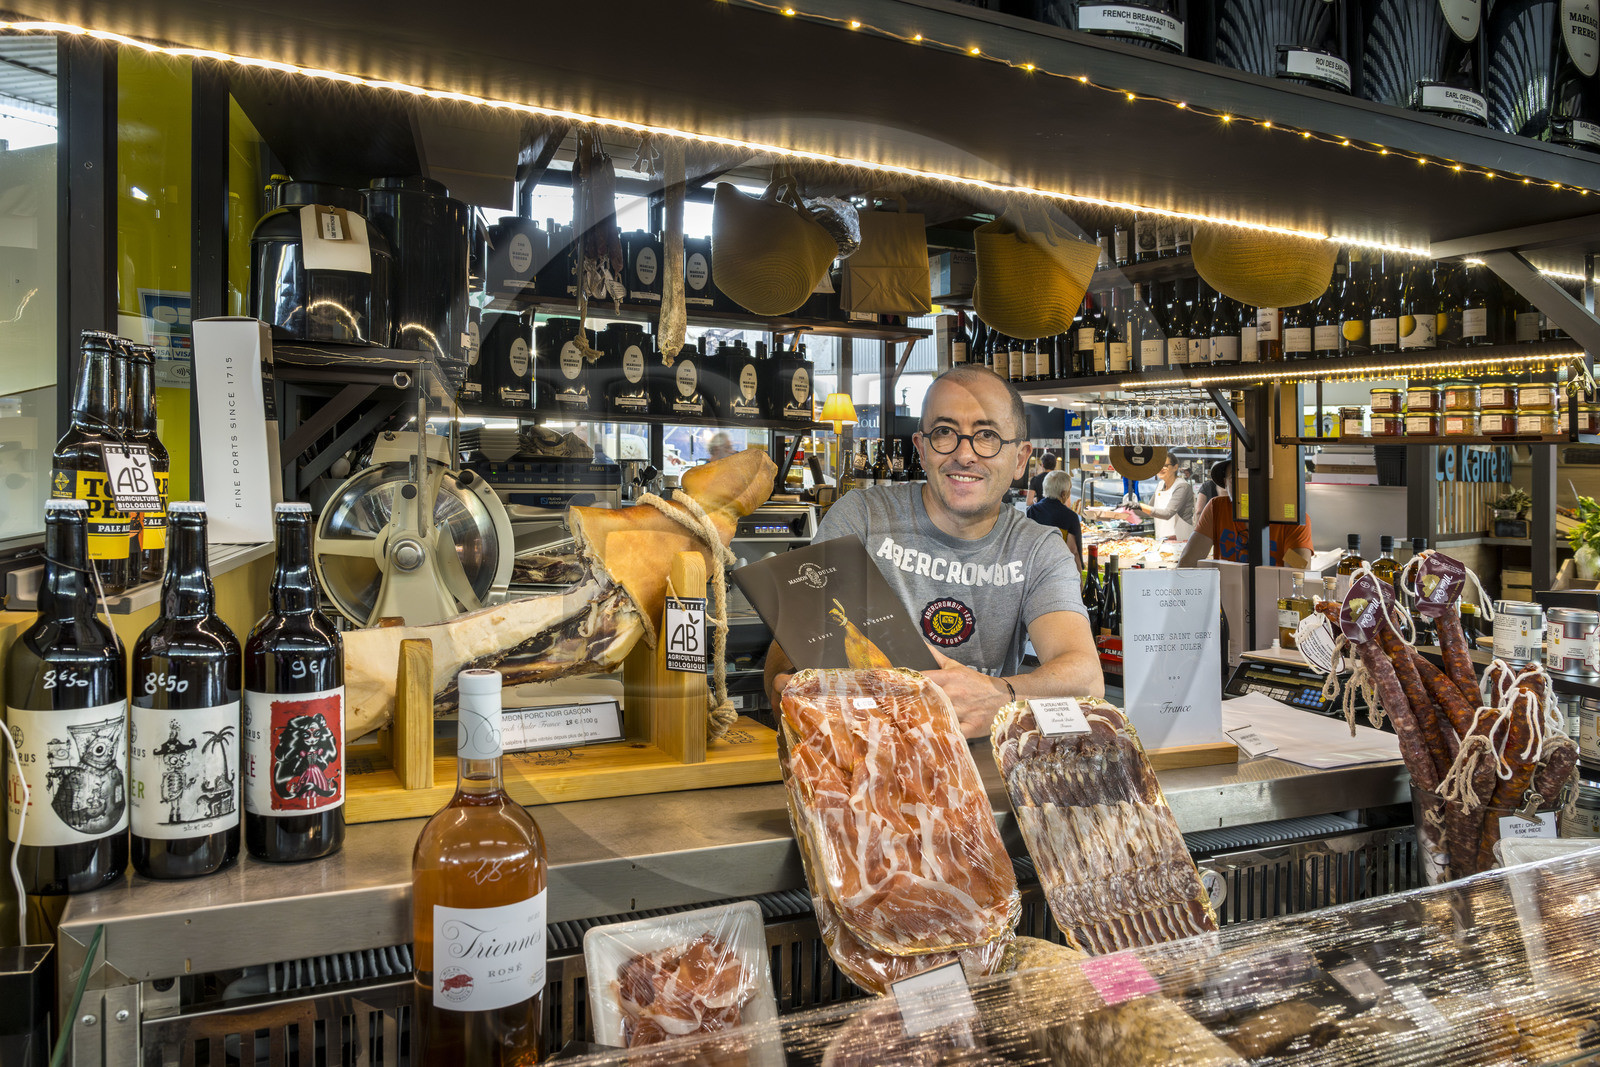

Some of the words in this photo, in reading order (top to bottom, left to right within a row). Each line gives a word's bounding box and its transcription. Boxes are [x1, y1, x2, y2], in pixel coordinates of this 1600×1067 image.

[1102, 10, 1131, 19] FRENCH
[1132, 12, 1166, 26] BREAKFAST
[1167, 20, 1176, 30] TEA
[1325, 60, 1334, 68] DES
[1445, 91, 1459, 99] EARL
[1460, 94, 1472, 102] GREY
[225, 357, 234, 384] 1715
[228, 392, 237, 428] SINCE
[231, 435, 240, 474] PORTS
[1435, 445, 1454, 481] Le
[117, 467, 149, 492] AB
[233, 480, 242, 508] FINE
[876, 537, 1025, 586] ABERCROMBIE
[788, 575, 808, 585] MAISON
[818, 567, 837, 576] DULER
[872, 614, 894, 624] COCHON
[924, 601, 962, 620] ABERCROMBIE
[671, 624, 698, 652] AB
[928, 631, 942, 643] NEW
[945, 635, 963, 644] YORK
[1145, 644, 1177, 652] PATRICK
[668, 654, 705, 662] AGRICULTURE
[668, 661, 705, 669] BIOLOGIQUE
[564, 708, 592, 716] GASCON
[1160, 702, 1192, 715] France
[468, 857, 504, 885] 28
[442, 919, 542, 959] Triennes
[488, 963, 523, 978] ROSÉ
